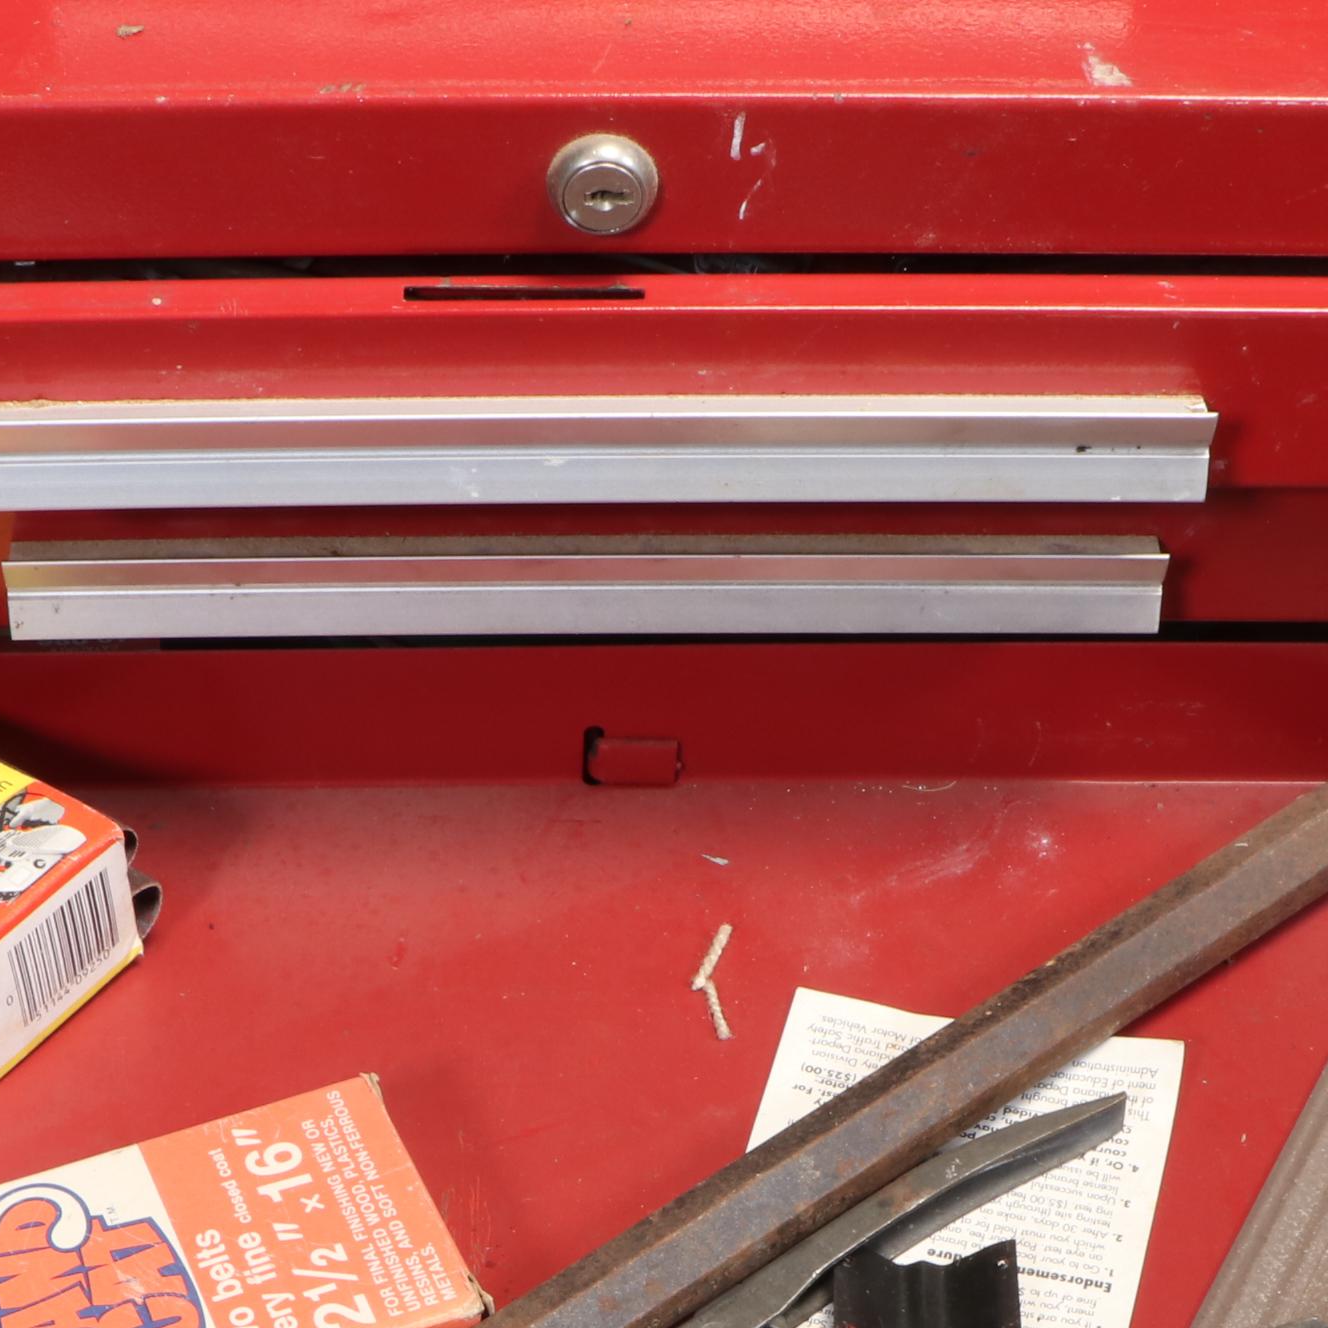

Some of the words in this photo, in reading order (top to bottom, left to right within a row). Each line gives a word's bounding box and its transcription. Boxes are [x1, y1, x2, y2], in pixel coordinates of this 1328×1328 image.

[792, 1083, 813, 1095] For
[301, 1119, 321, 1140] OR
[320, 1114, 358, 1180] PLASTICS,
[326, 1090, 380, 1182] NON-FERROUS
[208, 1148, 232, 1178] coat
[311, 1142, 334, 1174] NEW
[1089, 1156, 1100, 1166] if
[220, 1182, 252, 1224] closed
[300, 1193, 325, 1213] x
[327, 1174, 368, 1242] FINISHING
[351, 1179, 380, 1226] WOOD,
[370, 1184, 397, 1219] SOFT
[389, 1219, 413, 1249] AND
[195, 1229, 244, 1302] belts
[237, 1231, 277, 1285] fine
[361, 1243, 388, 1285] FINAL
[373, 1228, 421, 1313] UNFINISHED
[405, 1250, 440, 1307] RESINS,
[421, 1242, 457, 1301] METALS.
[1015, 1263, 1112, 1293] Endorsemen
[380, 1288, 404, 1317] FOR
